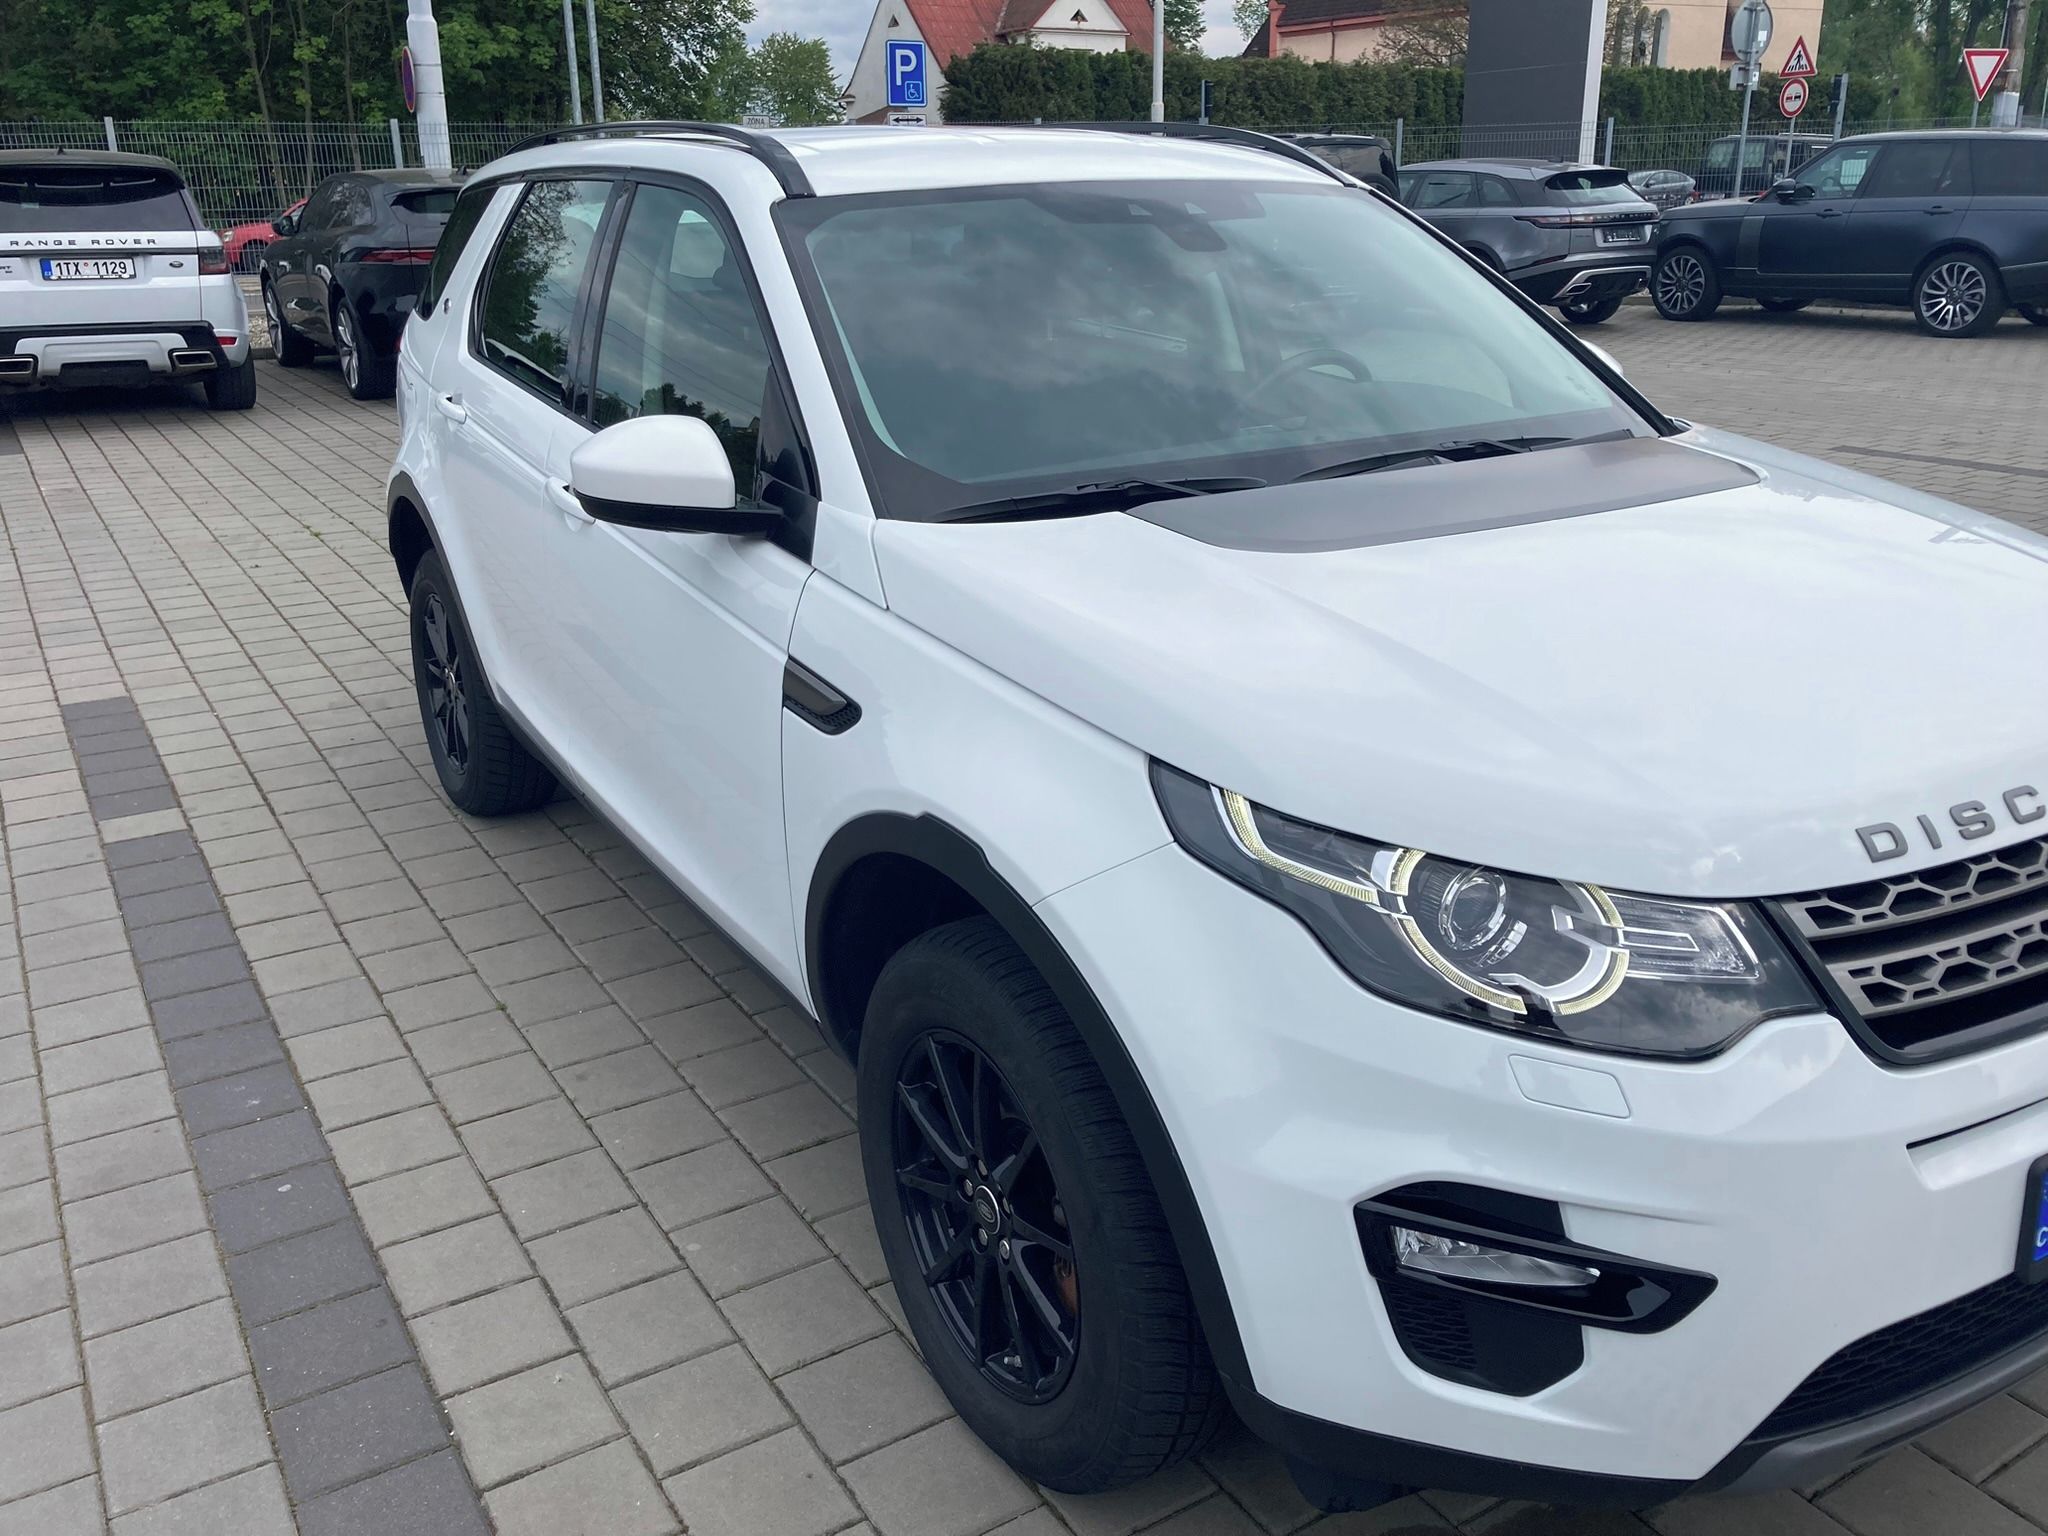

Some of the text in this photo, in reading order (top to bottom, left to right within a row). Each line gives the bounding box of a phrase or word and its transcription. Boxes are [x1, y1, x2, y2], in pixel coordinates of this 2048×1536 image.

[895, 49, 917, 86] P
[91, 238, 158, 246] ROVER
[55, 261, 127, 276] 1TX 1129
[1855, 785, 2047, 863] DISC
